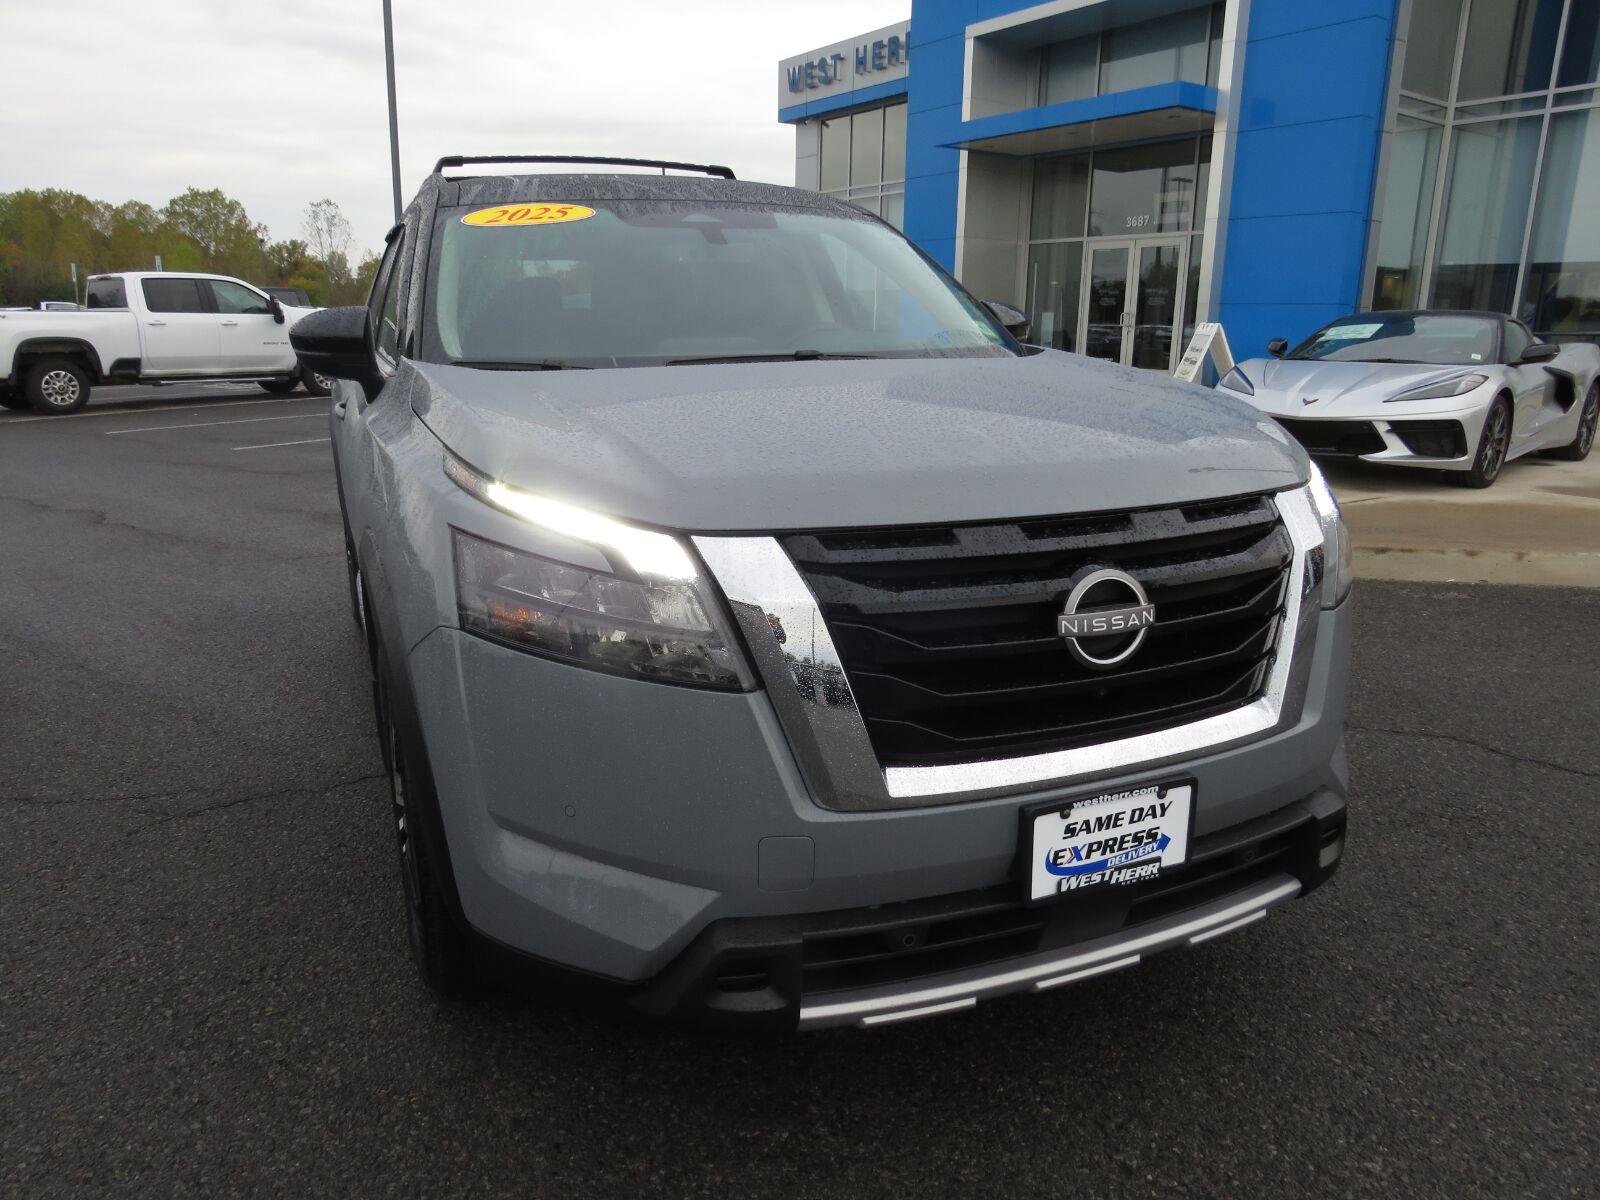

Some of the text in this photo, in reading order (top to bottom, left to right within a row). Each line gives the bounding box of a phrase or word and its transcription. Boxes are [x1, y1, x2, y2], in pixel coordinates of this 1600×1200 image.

[787, 53, 844, 94] WEST
[484, 206, 574, 224] 2025
[1126, 215, 1150, 227] 3687
[1061, 609, 1154, 633] NISSAN
[1072, 786, 1159, 809] westherr.com
[1062, 800, 1173, 840] SAME DAY
[1051, 826, 1161, 867] EXPRESS
[1107, 841, 1159, 867] DELIVERY
